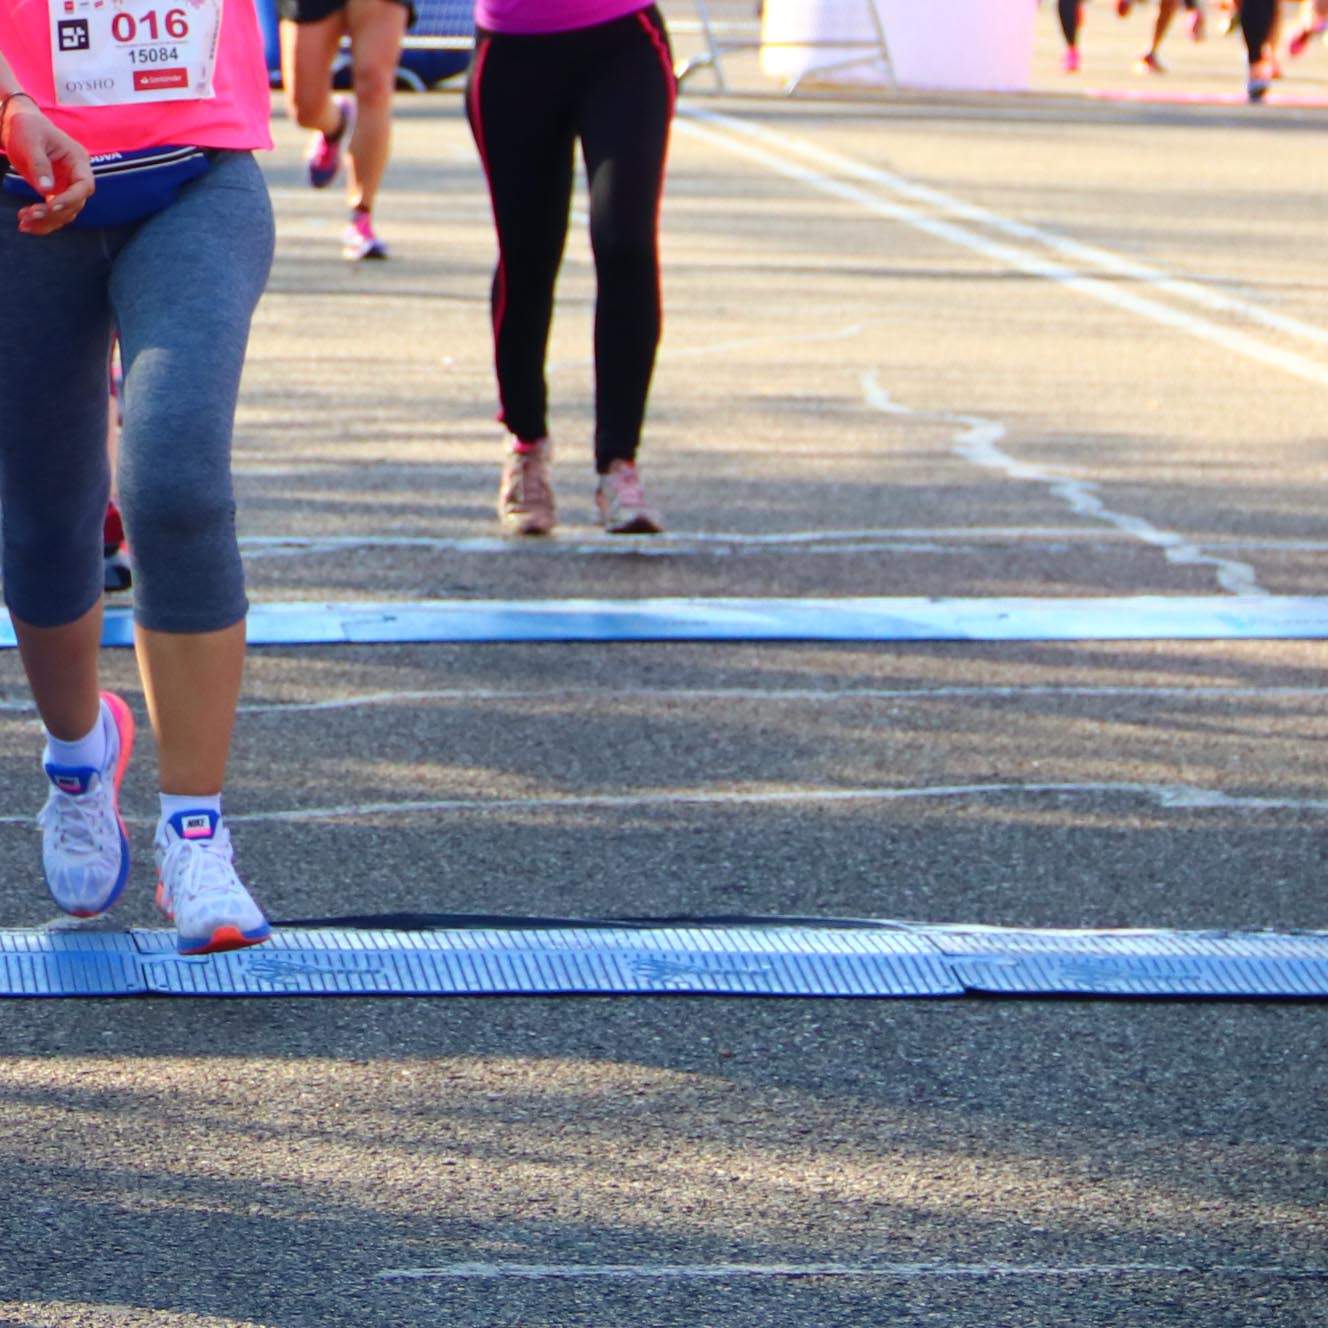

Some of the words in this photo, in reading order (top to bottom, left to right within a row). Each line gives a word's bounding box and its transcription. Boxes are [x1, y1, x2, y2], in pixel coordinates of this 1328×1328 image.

[112, 9, 189, 42] 016
[129, 47, 178, 64] 15084
[65, 78, 114, 92] OYSHO
